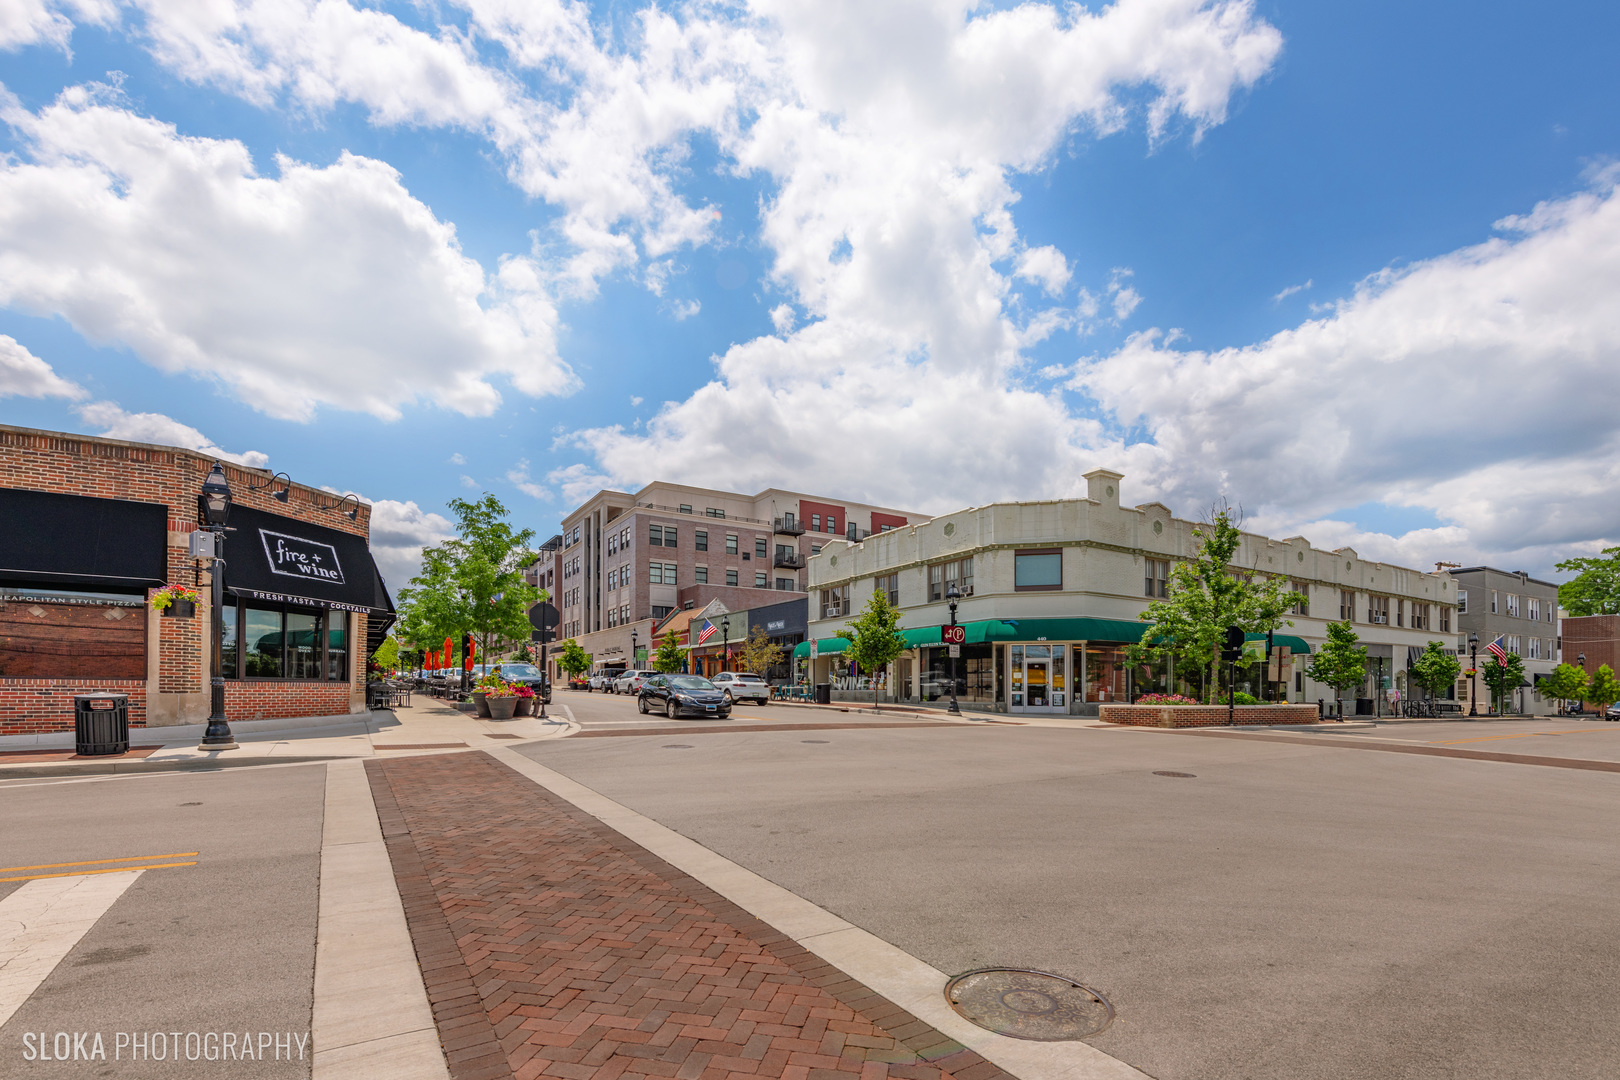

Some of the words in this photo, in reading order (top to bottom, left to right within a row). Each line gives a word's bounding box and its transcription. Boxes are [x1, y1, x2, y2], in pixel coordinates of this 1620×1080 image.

[275, 539, 309, 564] fire
[296, 563, 338, 579] wine
[253, 591, 284, 601] FRESH
[287, 596, 315, 606] PASTA
[330, 602, 371, 614] COCKTAILS
